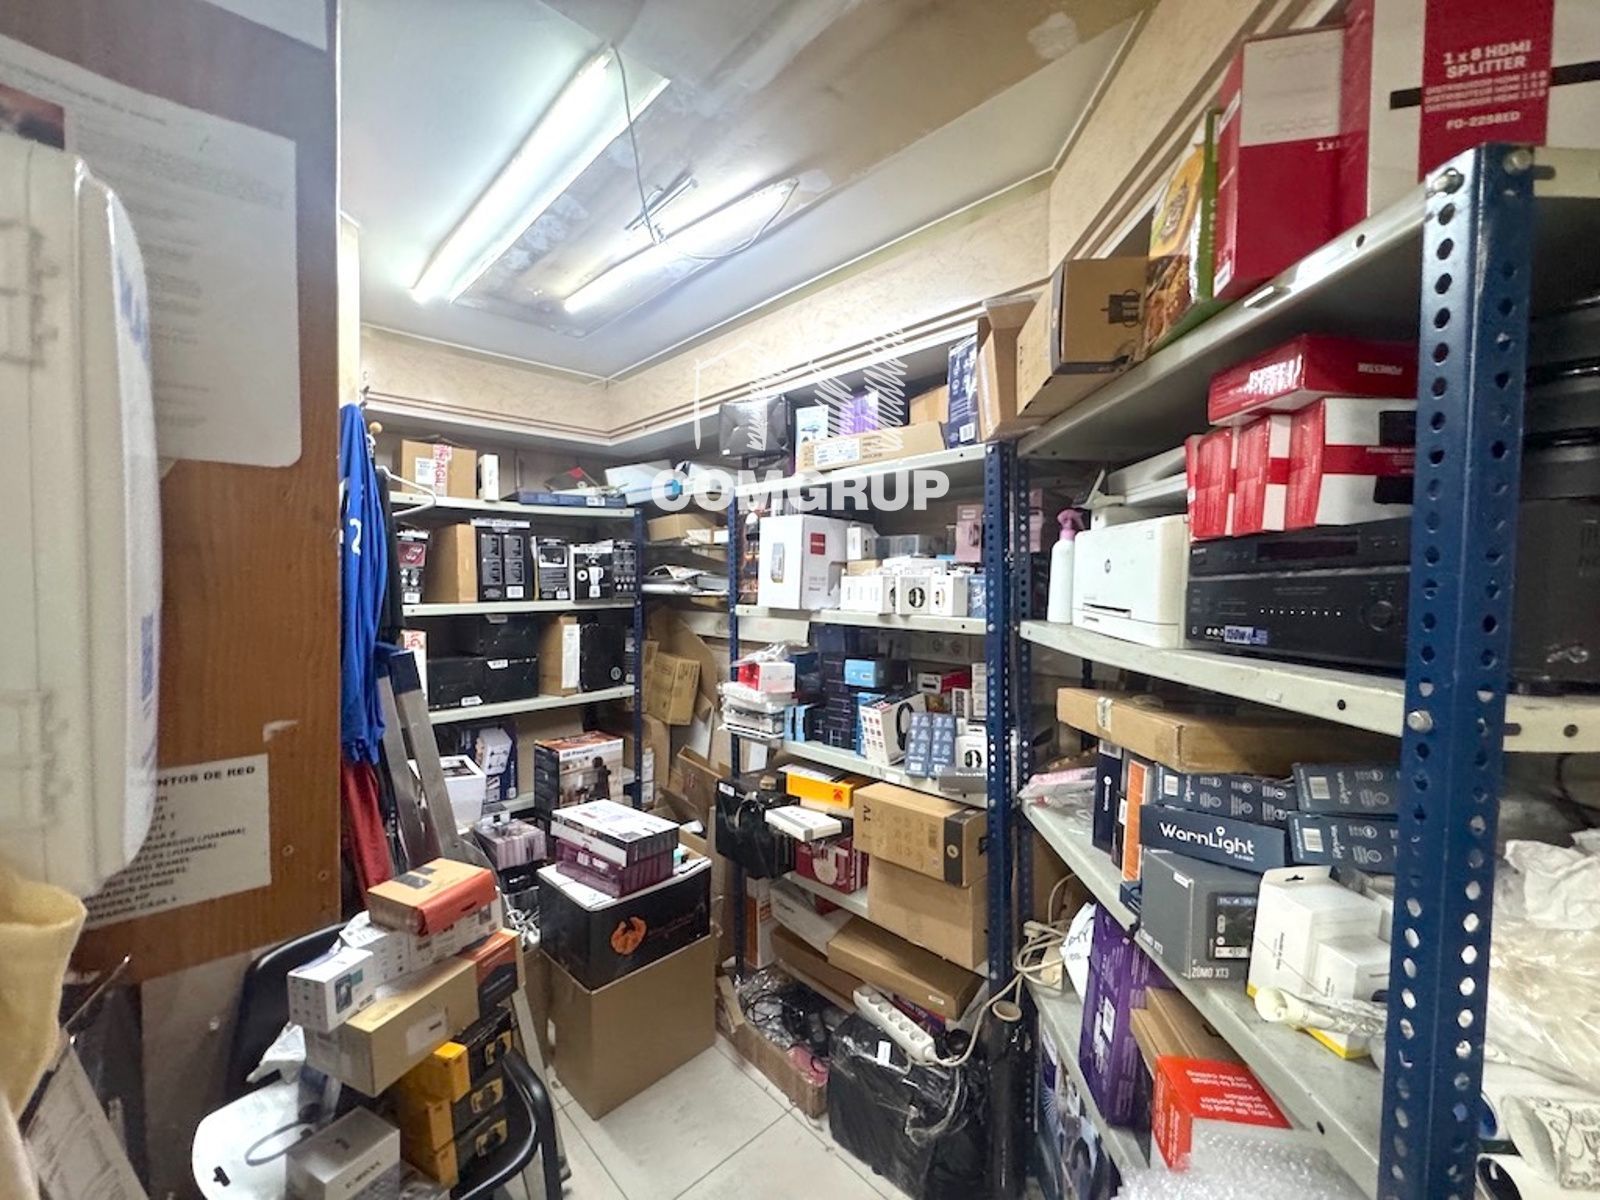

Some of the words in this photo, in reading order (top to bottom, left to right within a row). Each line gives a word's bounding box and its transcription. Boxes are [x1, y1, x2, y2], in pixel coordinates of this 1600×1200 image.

[1485, 39, 1532, 58] HDMI
[1446, 55, 1527, 79] SPLITTER
[204, 770, 222, 781] DE
[227, 765, 256, 777] RED
[864, 804, 872, 822] TV
[1159, 822, 1255, 856] WarnLight
[1215, 967, 1230, 978] XT3
